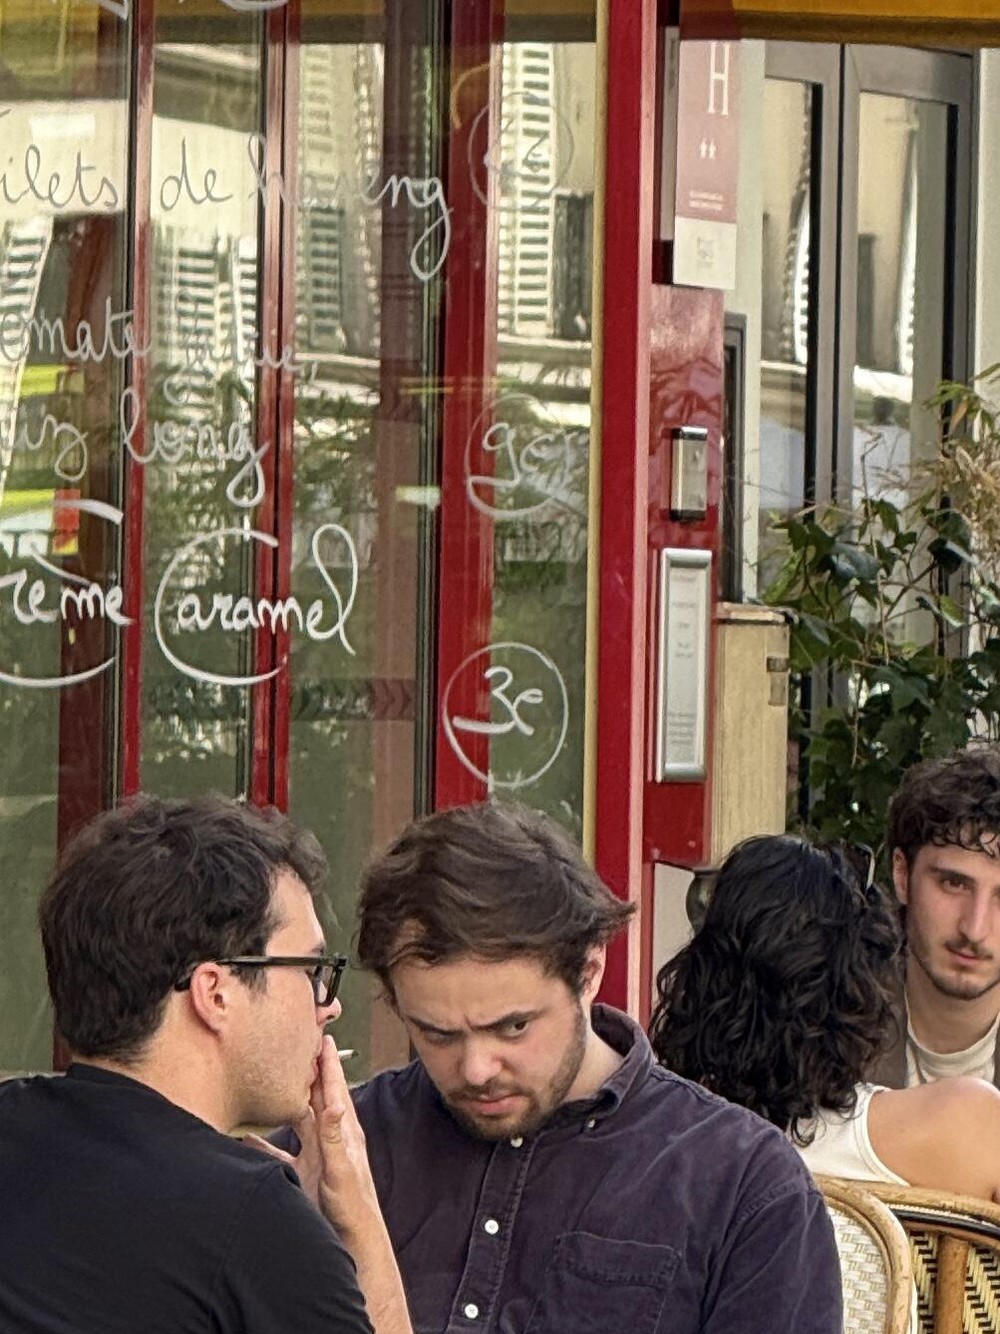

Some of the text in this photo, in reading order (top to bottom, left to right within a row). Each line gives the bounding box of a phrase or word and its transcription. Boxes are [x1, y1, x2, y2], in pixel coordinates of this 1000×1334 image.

[159, 137, 234, 211] de
[120, 386, 270, 508] long
[155, 526, 356, 686] Caramel
